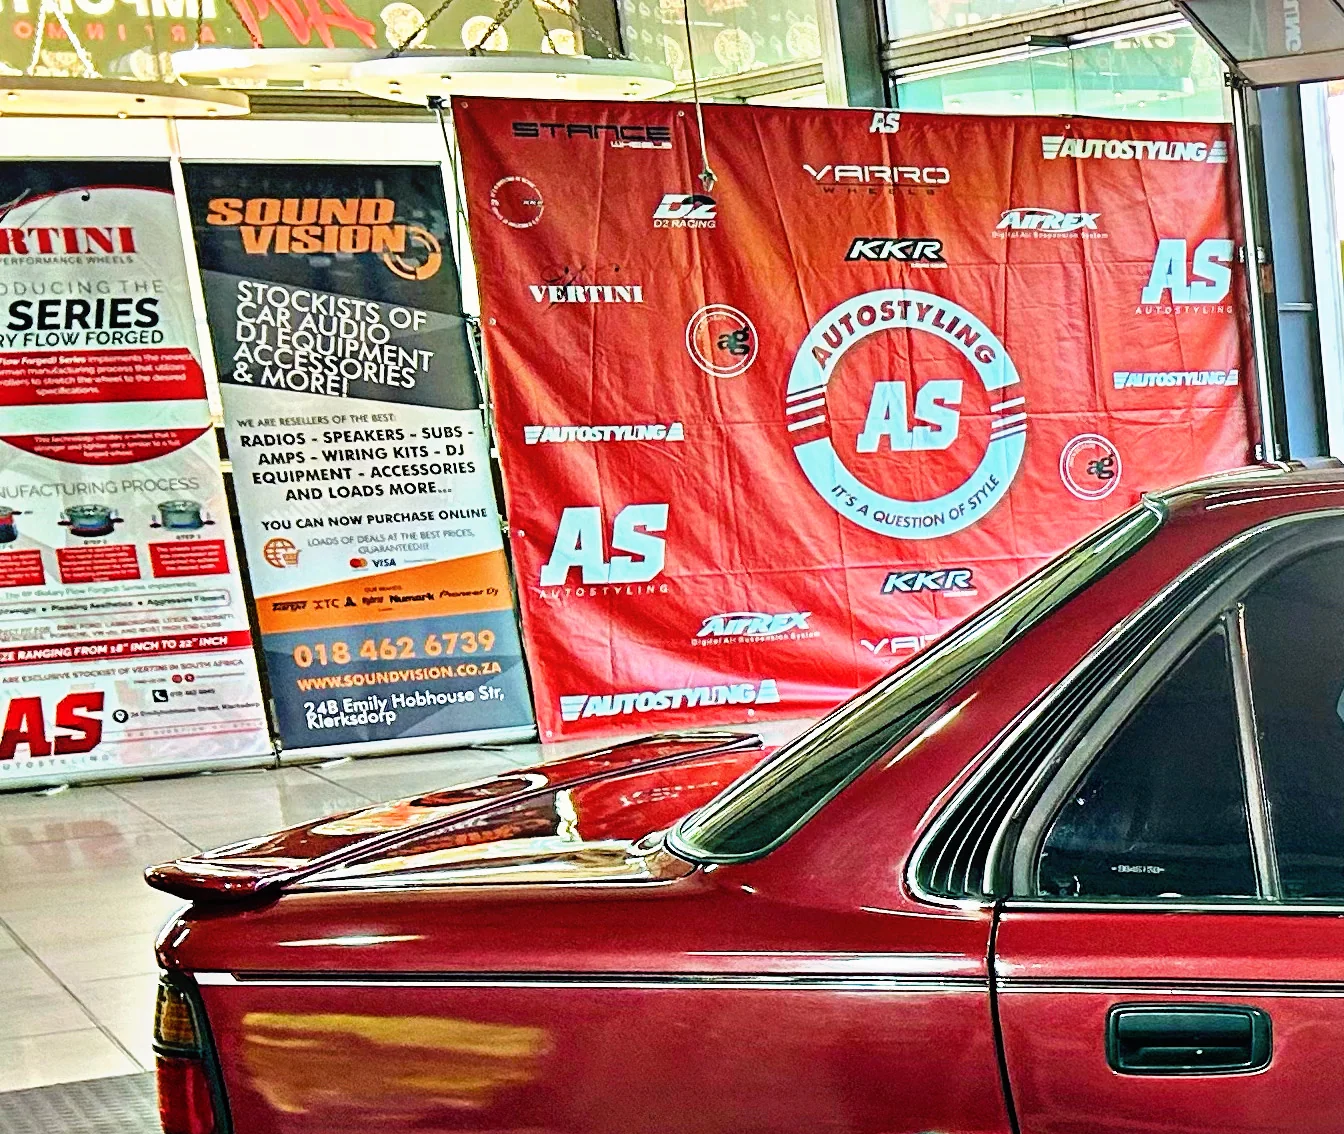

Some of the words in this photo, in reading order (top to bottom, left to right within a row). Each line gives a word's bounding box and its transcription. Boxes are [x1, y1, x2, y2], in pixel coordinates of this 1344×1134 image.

[512, 122, 671, 141] STANCE
[869, 112, 900, 133] AS
[1060, 139, 1208, 162] AUTOSTYLING
[802, 164, 950, 184] VARRO
[823, 187, 935, 196] WHEELS
[206, 198, 395, 225] SOUND
[653, 193, 718, 219] D2
[653, 219, 669, 228] D2
[671, 219, 716, 229] RACING
[240, 225, 407, 254] VISION
[847, 239, 944, 260] KKR
[86, 256, 134, 265] WHEELS
[1141, 238, 1235, 304] AS
[116, 280, 165, 294] THE
[529, 285, 643, 303] VERTINI
[7, 298, 160, 330] SERIES
[237, 281, 380, 324] STOCKISTS
[389, 307, 427, 331] OF
[1135, 306, 1233, 314] AUTOSTYLING
[236, 303, 291, 330] CAR
[299, 311, 391, 345] AUDIO
[811, 300, 996, 370] AUTOSTYLING
[23, 332, 80, 347] FLOW
[86, 330, 164, 346] FORGED
[236, 321, 268, 344] DJ
[277, 327, 435, 372] EQUIPMENT
[233, 342, 416, 389] ACCESSORIES
[233, 362, 254, 383] &
[261, 366, 348, 398] MORE!
[1127, 371, 1226, 387] AUTOSTYLING
[237, 419, 254, 428] WE
[257, 418, 276, 427] ARE
[279, 415, 329, 426] RESELLERS
[332, 415, 346, 424] OF
[349, 414, 368, 423] THE
[856, 379, 963, 453] AS
[240, 433, 306, 447] RADIOS
[323, 428, 405, 444] SPEAKERS
[422, 426, 463, 439] SUBS
[541, 426, 667, 443] AUTOSTYLING
[258, 451, 305, 465] AMPS
[322, 447, 387, 462] WIRING
[393, 446, 428, 459] KITS
[446, 444, 464, 457] DJ
[252, 467, 352, 484] EQUIPMENT
[370, 461, 476, 478] ACCESSORIES
[122, 478, 200, 492] PROCESS
[285, 487, 323, 501] AND
[328, 483, 384, 498] LOADS
[389, 481, 452, 497] MORE...
[831, 484, 855, 506] IT'S
[857, 505, 868, 516] A
[873, 510, 945, 528] QUESTION
[948, 503, 966, 521] OF
[968, 474, 1000, 510] STYLE
[261, 518, 292, 531] YOU
[295, 517, 324, 529] CAN
[328, 515, 362, 527] NOW
[367, 511, 435, 525] PURCHASE
[438, 508, 488, 519] ONLINE
[307, 536, 339, 547] LOADS
[341, 535, 355, 545] OF
[357, 534, 385, 544] DEALS
[388, 533, 398, 541] AT
[400, 532, 417, 540] THE
[420, 531, 440, 539] BEST
[540, 503, 669, 587] AS
[372, 558, 397, 567] VISA
[540, 584, 669, 600] AUTOSTYLING
[884, 569, 972, 593] KKR
[17, 648, 73, 661] RANGING
[74, 645, 107, 657] FROM
[130, 641, 159, 653] INCH
[161, 640, 177, 650] TO
[199, 636, 228, 646] INCH
[293, 641, 350, 668] 018
[360, 636, 416, 661] 462
[424, 629, 496, 657] 6739
[297, 662, 502, 692] WWW.SOUNDVISION.CO.ZA
[304, 700, 339, 716] 24B
[344, 696, 387, 715] Emily
[392, 689, 474, 708] Hobhouse
[479, 685, 504, 702] Str,
[582, 683, 757, 717] AUTOSTYLING
[0, 691, 104, 761] AS
[307, 709, 397, 730] Klerksdorp
